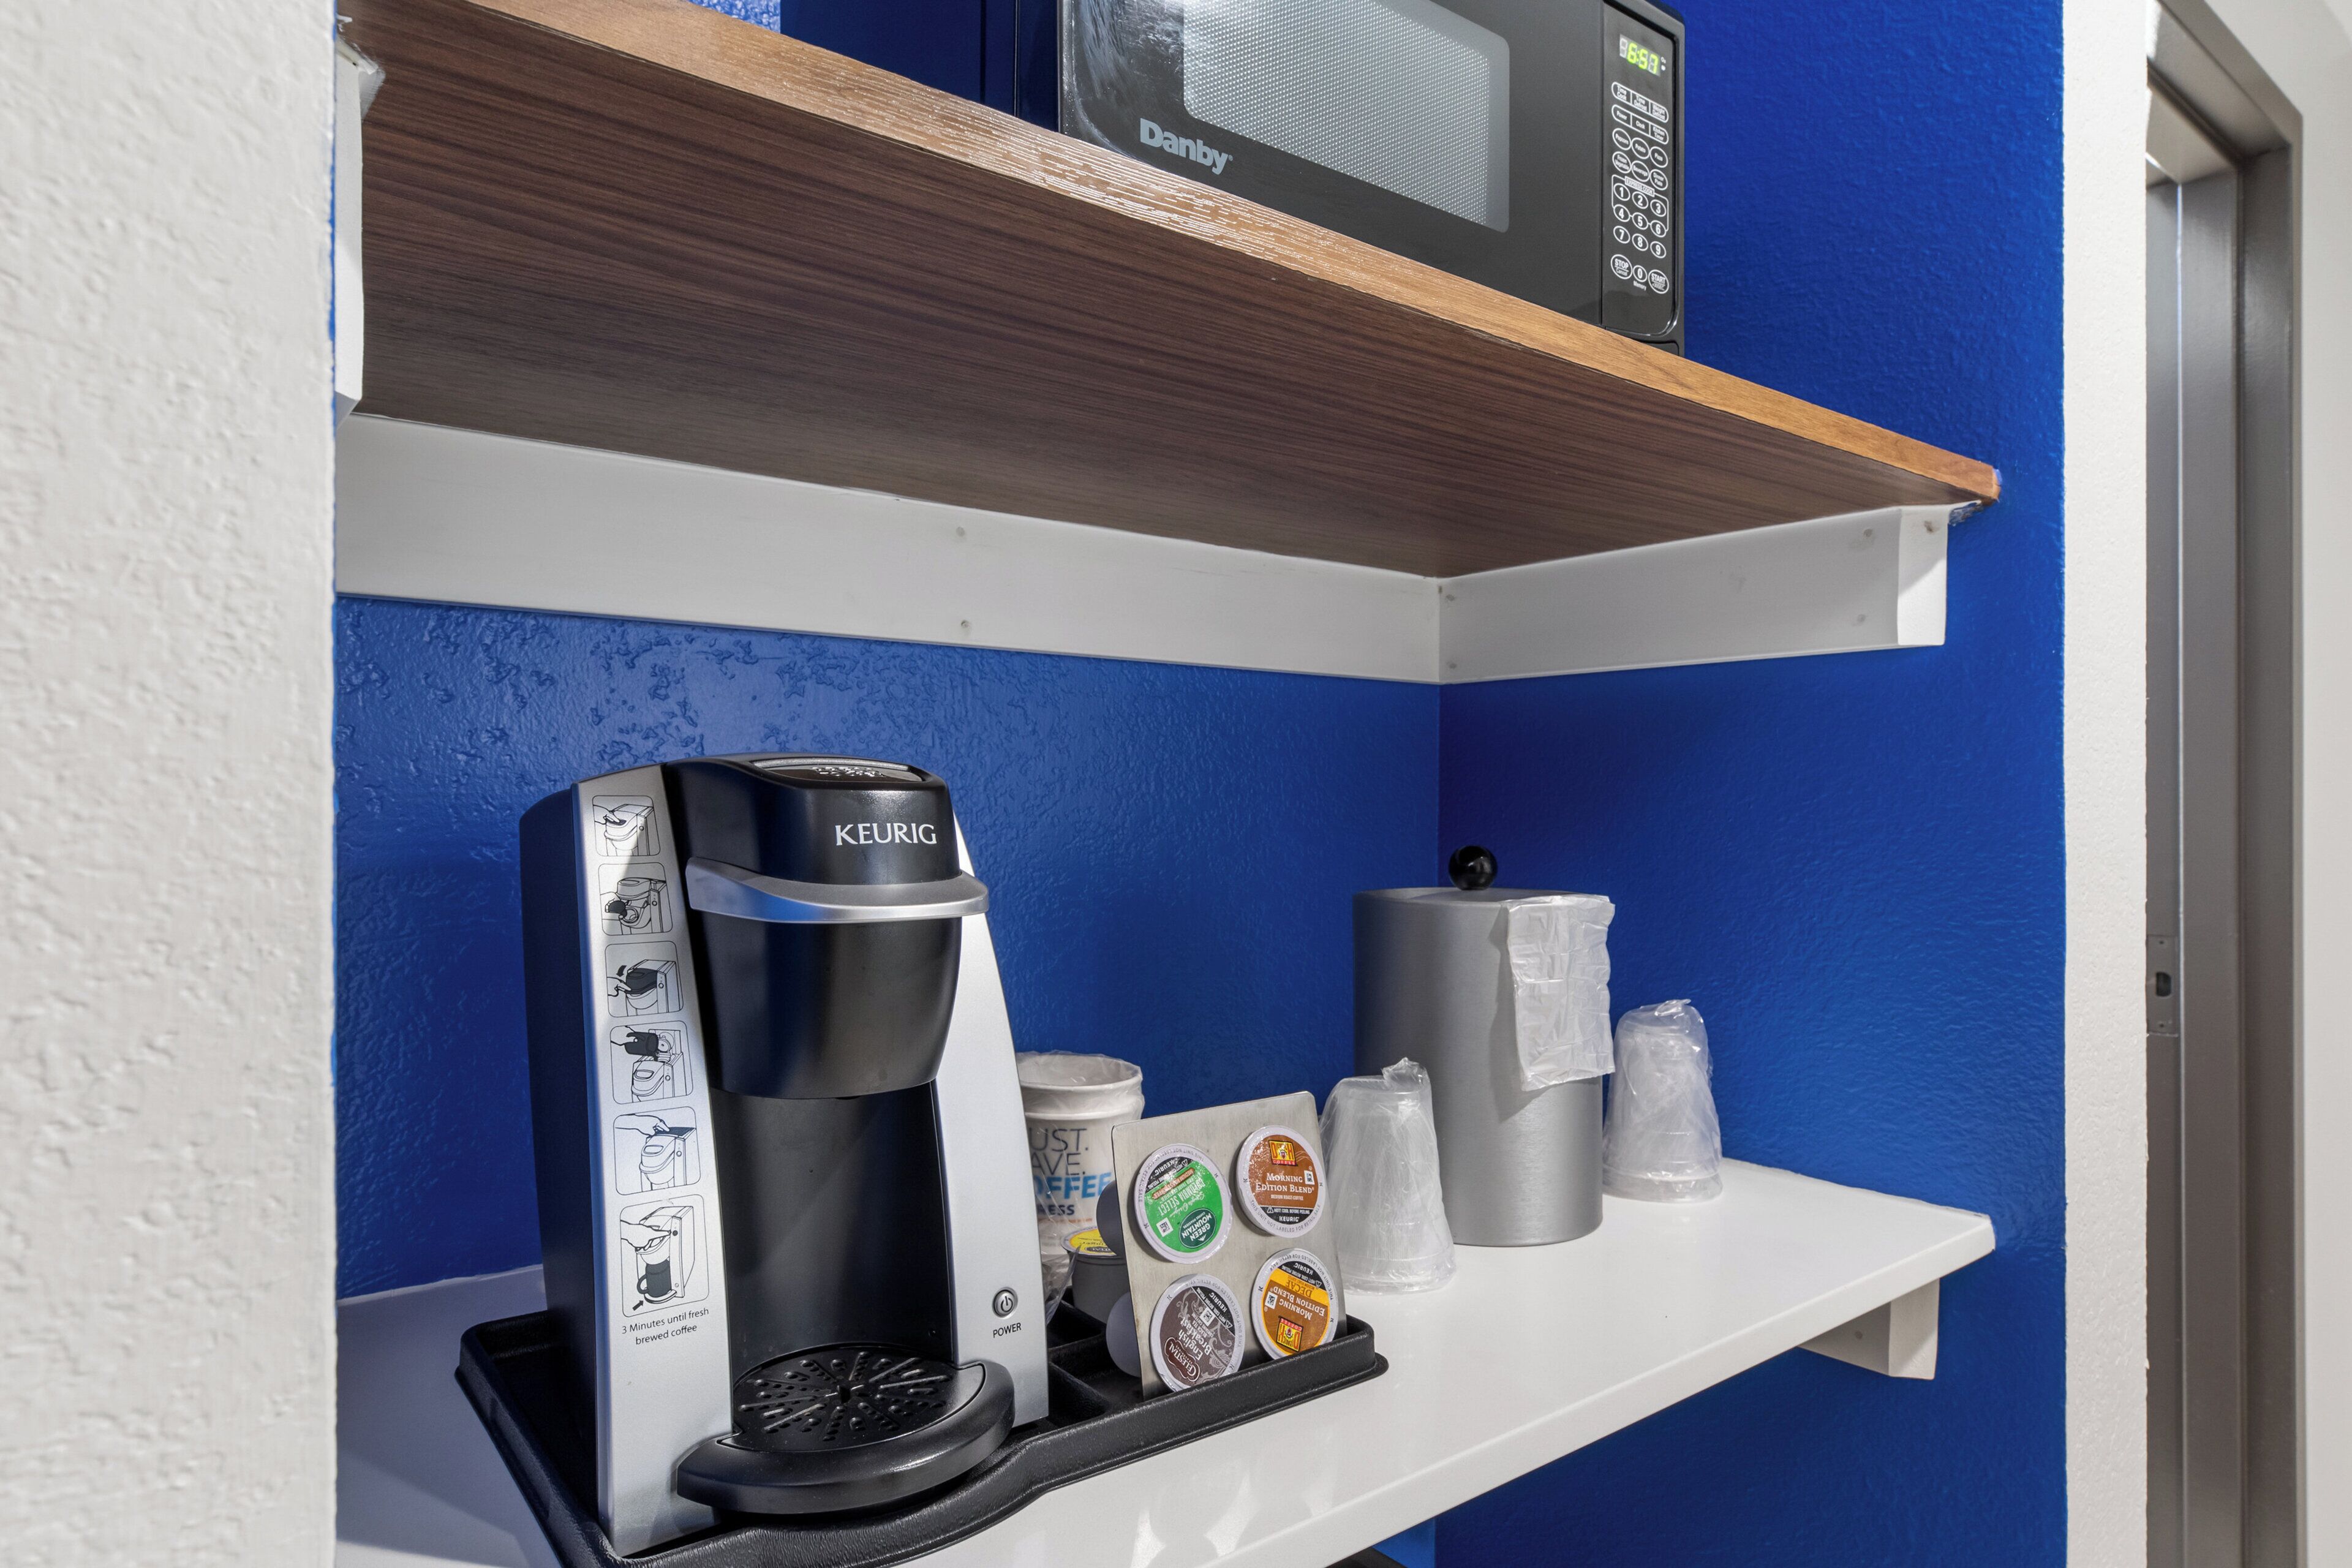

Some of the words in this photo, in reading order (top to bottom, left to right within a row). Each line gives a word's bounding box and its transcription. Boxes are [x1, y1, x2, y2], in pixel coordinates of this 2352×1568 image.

[1627, 42, 1658, 74] 6:57
[1617, 85, 1627, 96] Time
[1635, 94, 1646, 105] Time
[1616, 110, 1627, 120] Power
[1140, 118, 1228, 175] Danby
[1619, 187, 1624, 198] 1
[1637, 195, 1643, 206] 2
[1618, 208, 1624, 219] 4
[1656, 203, 1660, 214] 3
[1637, 216, 1643, 227] 5
[1619, 228, 1624, 240] 7
[1656, 224, 1660, 235] 6
[1637, 236, 1643, 247] 8
[1656, 244, 1660, 255] 9
[1615, 258, 1629, 270] STOP
[1637, 268, 1643, 279] 0
[1651, 273, 1665, 284] START
[835, 823, 937, 846] KEURIG
[1029, 1128, 1088, 1152] UST.
[1031, 1152, 1085, 1175] AVE.
[1155, 1160, 1175, 1175] KEURIG
[1267, 1172, 1303, 1183] MORNING
[1035, 1172, 1112, 1199] FFEE
[1256, 1182, 1288, 1192] EDITION
[1290, 1185, 1313, 1194] BLEND
[1158, 1195, 1180, 1215] SELECT
[1257, 1211, 1267, 1222] UNIT
[1181, 1212, 1212, 1238] MOUNTAIN
[1189, 1223, 1211, 1242] GREEN
[1294, 1262, 1314, 1276] KEURIG
[1273, 1286, 1295, 1302] BLEND
[1286, 1280, 1313, 1298] DECAF
[1209, 1292, 1227, 1313] KEURIG
[1279, 1299, 1313, 1320] MORNING
[1295, 1297, 1325, 1316] EDITION
[622, 1325, 627, 1334] 3
[629, 1319, 666, 1332] Minutes
[667, 1311, 687, 1324] until
[688, 1307, 709, 1319] fresh
[635, 1330, 669, 1345] brewed
[671, 1324, 697, 1337] coffee
[993, 1322, 1022, 1338] POWER
[1180, 1317, 1212, 1355] Breakfast
[1197, 1325, 1208, 1338] BLACK
[1178, 1329, 1204, 1360] English
[1169, 1341, 1197, 1376] CELESTIAL
